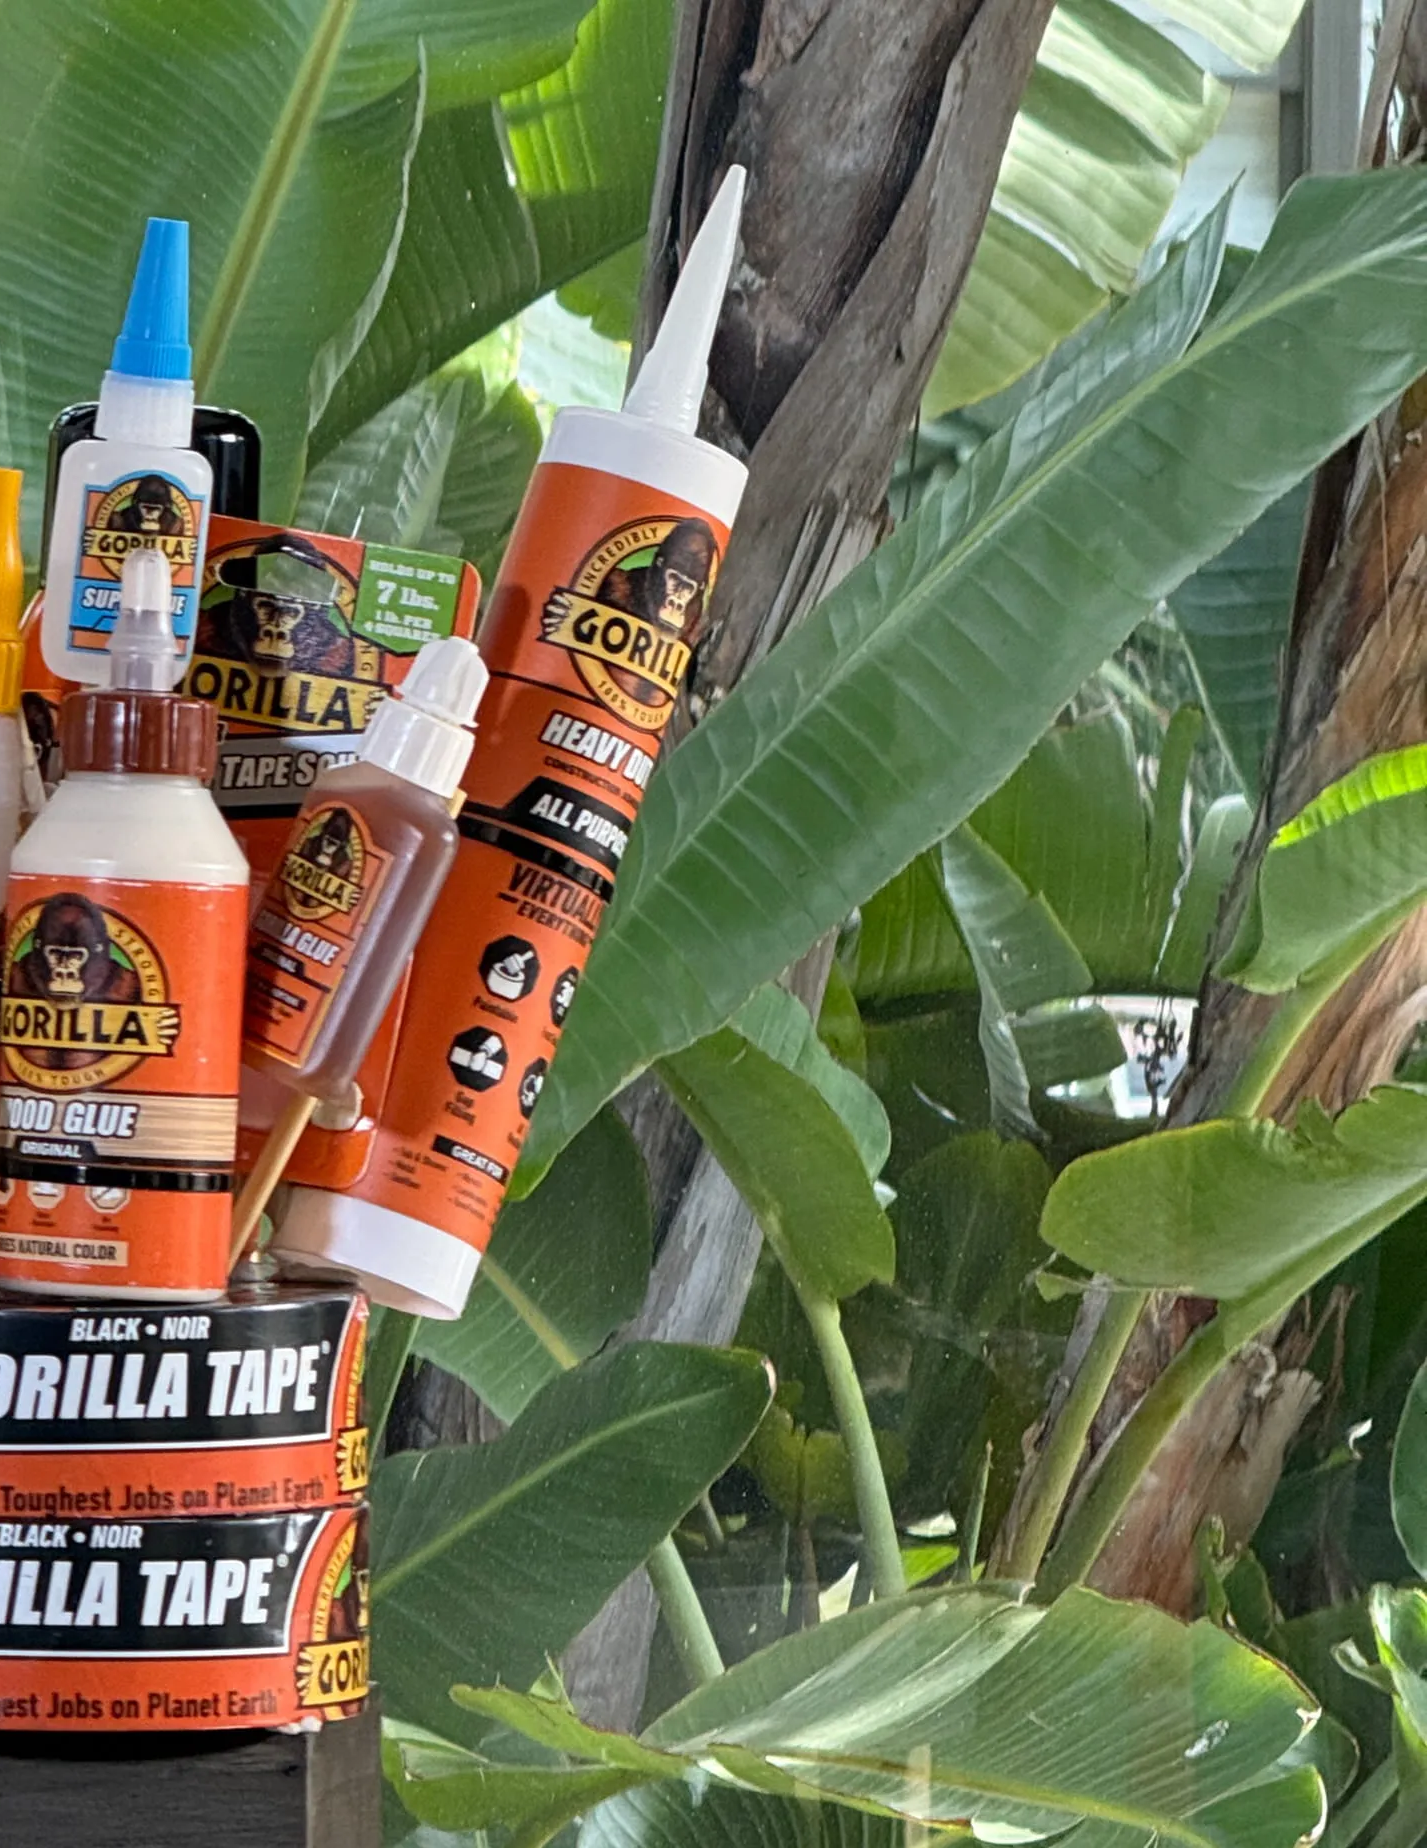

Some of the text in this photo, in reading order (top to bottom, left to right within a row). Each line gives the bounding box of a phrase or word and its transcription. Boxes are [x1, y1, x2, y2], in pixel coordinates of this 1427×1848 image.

[581, 526, 659, 589] INCREDIBLY
[83, 586, 122, 610] SUP
[377, 579, 397, 605] 7
[190, 661, 355, 733] ORILLA
[597, 679, 627, 711] 100%
[540, 712, 631, 771] HEAVY
[221, 754, 291, 789] TAPE
[529, 794, 575, 829] ALL
[286, 859, 348, 905] GORILLA
[114, 928, 160, 998] STRONG
[295, 931, 342, 967] GLUE
[2, 1003, 149, 1046] GORILLA
[50, 1069, 106, 1087] TOUGH
[8, 1098, 139, 1137] OOD GLUE
[20, 1140, 83, 1158] ORIGINAL
[18, 1239, 70, 1258] NATURAL
[73, 1243, 117, 1260] COLOR
[69, 1316, 212, 1342] BLACK NOIR
[206, 1345, 321, 1417] TAPE
[120, 1484, 175, 1512] Jobs
[180, 1488, 208, 1508] on
[213, 1481, 279, 1508] Planet
[89, 1524, 144, 1549] NOIR
[139, 1557, 274, 1627] TAPE
[46, 1691, 104, 1720] Jobs
[110, 1697, 141, 1720] on
[147, 1692, 222, 1719] Planet
